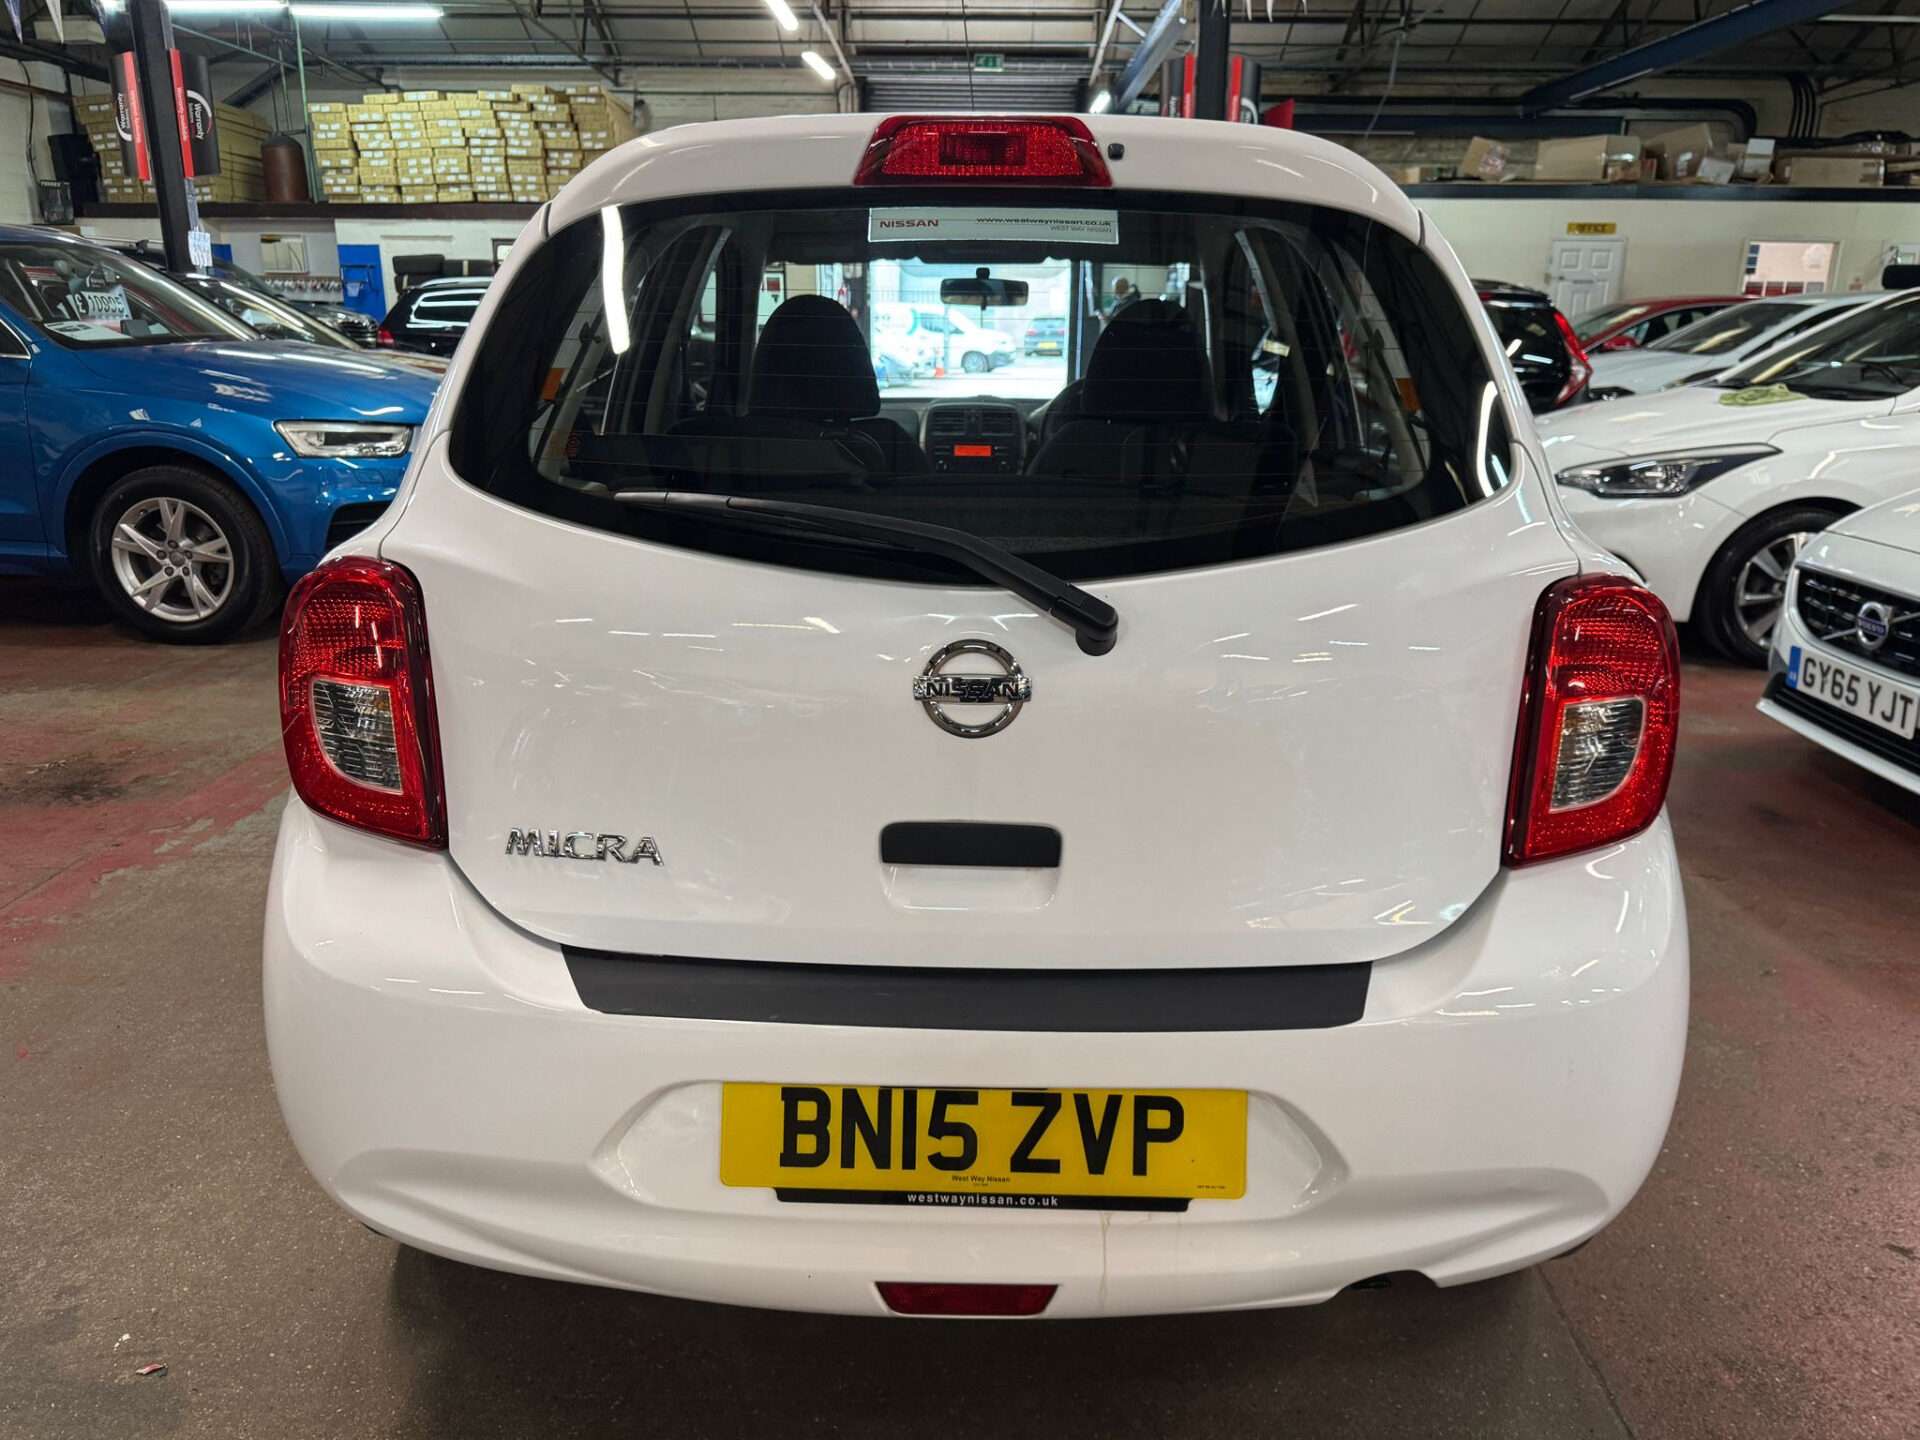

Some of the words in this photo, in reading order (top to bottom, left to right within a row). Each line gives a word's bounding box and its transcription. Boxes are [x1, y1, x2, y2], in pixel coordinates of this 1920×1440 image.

[194, 103, 205, 140] Warranty
[879, 218, 939, 229] NISSAN
[925, 680, 1020, 699] NISSAN
[1802, 656, 1861, 707] GY65
[1867, 681, 1914, 730] YJT
[505, 827, 664, 867] MICRA
[779, 1086, 979, 1172] BN15
[1009, 1092, 1185, 1177] ZVP
[970, 1175, 985, 1183] Way
[986, 1175, 1010, 1183] Nissan
[907, 1193, 1058, 1206] westwaynissan.co.uk
